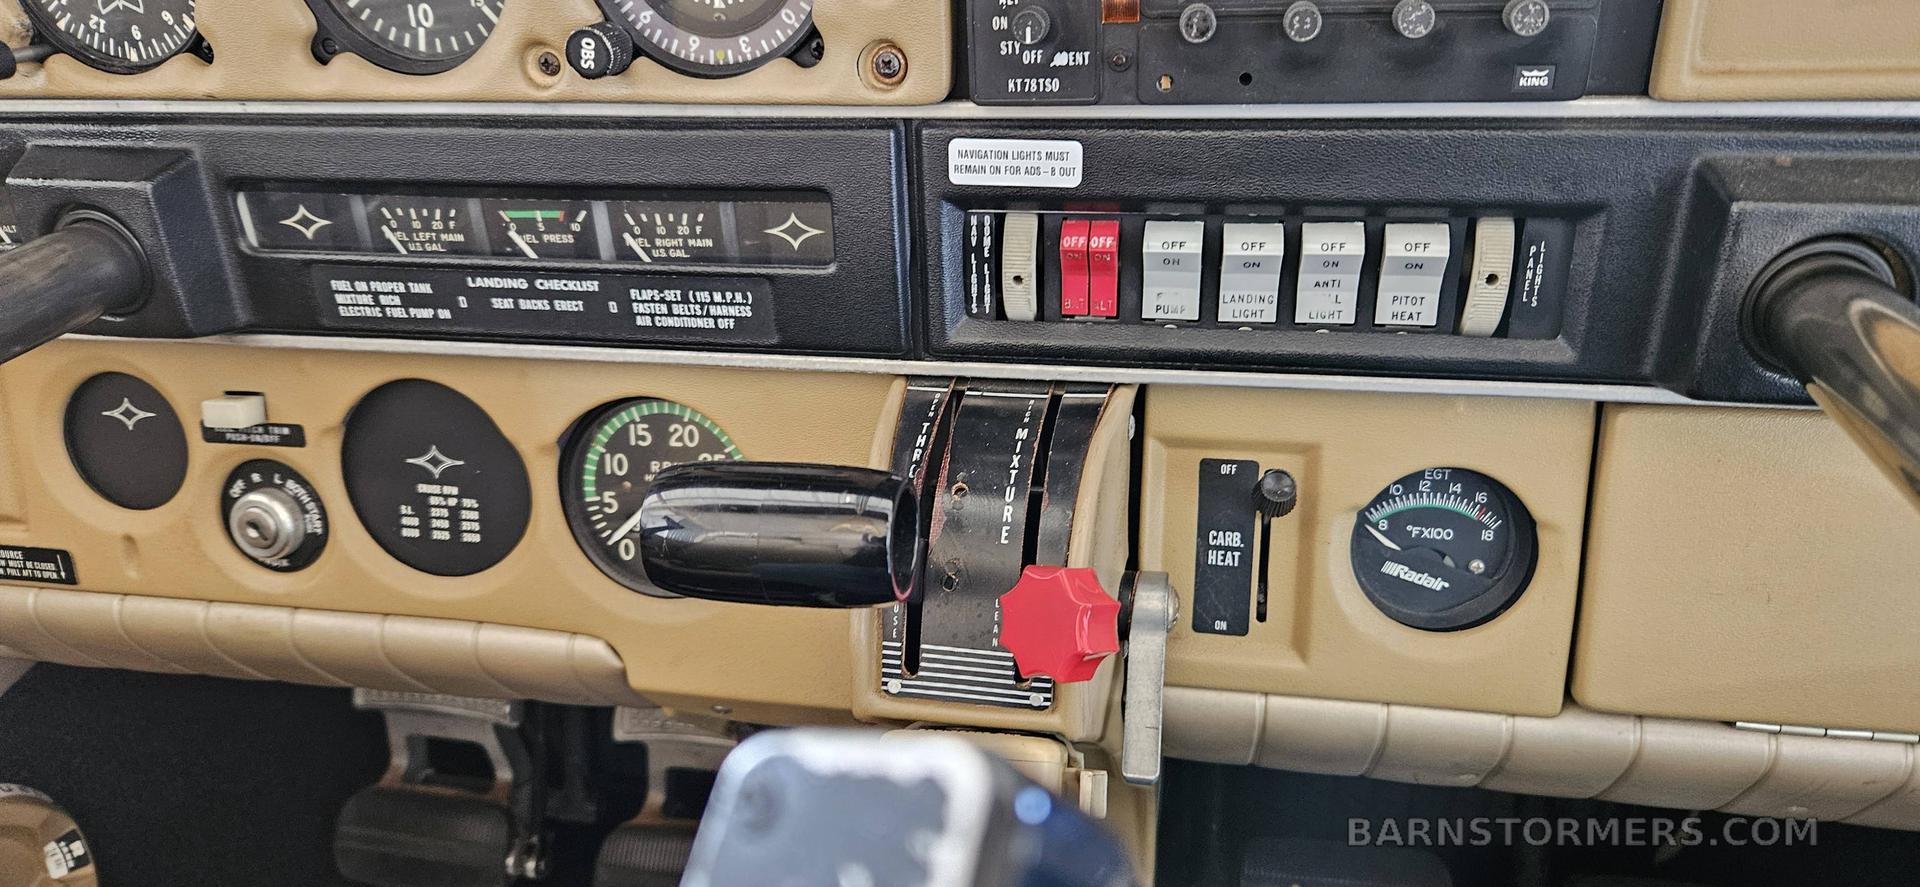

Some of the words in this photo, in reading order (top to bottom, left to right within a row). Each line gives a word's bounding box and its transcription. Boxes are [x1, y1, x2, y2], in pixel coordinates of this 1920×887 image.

[407, 3, 434, 28] 10
[992, 16, 1008, 31] ON
[580, 37, 595, 70] OBS
[1000, 40, 1021, 55] STY
[1022, 49, 1044, 65] OFF
[1050, 51, 1090, 68] ENT
[1519, 76, 1549, 87] KING
[957, 149, 1009, 160] NAVIGATION
[1011, 150, 1043, 161] LIGHTS
[1045, 151, 1070, 161] MUST
[953, 164, 987, 175] REMAIN
[989, 165, 1001, 175] ON
[1004, 166, 1020, 175] FOR
[1059, 167, 1076, 177] OUT
[390, 220, 397, 229] 0
[412, 220, 422, 230] 10
[431, 221, 444, 230] 20
[448, 221, 456, 230] F
[509, 223, 517, 231] 0
[537, 222, 545, 231] 5
[570, 223, 581, 232] 10
[633, 226, 641, 235] 0
[656, 226, 666, 235] 10
[677, 226, 690, 235] 20
[695, 226, 702, 235] F
[413, 232, 437, 241] LEFT
[439, 233, 465, 242] MAIN
[518, 234, 539, 244] UEL
[543, 234, 574, 243] PRESS
[983, 215, 991, 258] DOME
[1063, 236, 1086, 248] OFF
[1089, 236, 1114, 248] OFF
[625, 238, 651, 247] FEL
[655, 238, 683, 247] RIGHT
[687, 238, 713, 248] MAIN
[1161, 240, 1187, 250] OFF
[1241, 241, 1267, 251] OFF
[1321, 242, 1346, 252] OFF
[1404, 242, 1431, 252] OFF
[669, 249, 691, 258] GAL.
[1243, 261, 1261, 269] ON
[1322, 260, 1339, 268] ON
[1522, 245, 1537, 302] PANEL
[1531, 240, 1546, 308] LIGHTS
[330, 280, 354, 292] FUEL
[354, 281, 368, 292] ON
[369, 281, 406, 293] PROPER
[408, 282, 434, 294] TANK
[466, 277, 528, 289] LANDING
[534, 278, 599, 292] CHECKLIST
[970, 252, 978, 314] LIGHTS
[1313, 279, 1341, 288] ANTI
[334, 293, 376, 305] MIXTURE
[379, 294, 402, 306] RICH
[629, 289, 682, 302] FLAPS-SET
[688, 290, 711, 304] (115
[713, 291, 753, 305] M.P.H.)
[1222, 294, 1274, 305] LANDING
[1392, 295, 1426, 306] PITOT
[491, 298, 515, 309] SEAT
[518, 299, 550, 311] BACKS
[553, 300, 584, 312] ERECT
[632, 302, 668, 315] FASTEN
[338, 306, 383, 317] ELECTRIC
[385, 307, 409, 318] FUEL
[408, 308, 435, 319] PUMP
[437, 308, 452, 320] ON
[1232, 309, 1265, 319] LIGHT
[1308, 310, 1343, 320] LIGHT
[1392, 311, 1422, 321] HEAT
[636, 315, 653, 326] AIR
[655, 317, 715, 329] CONDITIONER
[717, 318, 735, 330] OFF
[628, 424, 652, 447] 15
[668, 424, 699, 447] 20
[604, 453, 629, 476] 10
[650, 461, 682, 473] RP
[1220, 463, 1237, 475] OFF
[273, 473, 283, 484] L
[1424, 469, 1452, 480] EGT
[229, 479, 247, 498] OFF
[1001, 427, 1029, 544] MIXTURE
[1389, 484, 1403, 495] 10
[1418, 480, 1431, 492] 12
[1449, 482, 1462, 494] 14
[602, 491, 619, 514] 5
[1475, 492, 1488, 503] 16
[1378, 519, 1388, 531] 8
[1208, 530, 1245, 548] CARB.
[1481, 530, 1494, 541] 18
[0, 550, 24, 559] OURCE
[618, 538, 635, 561] 0
[1207, 549, 1241, 567] HEAT
[1394, 564, 1449, 592] Radair
[991, 598, 1000, 647] LEAN
[1214, 620, 1227, 631] ON
